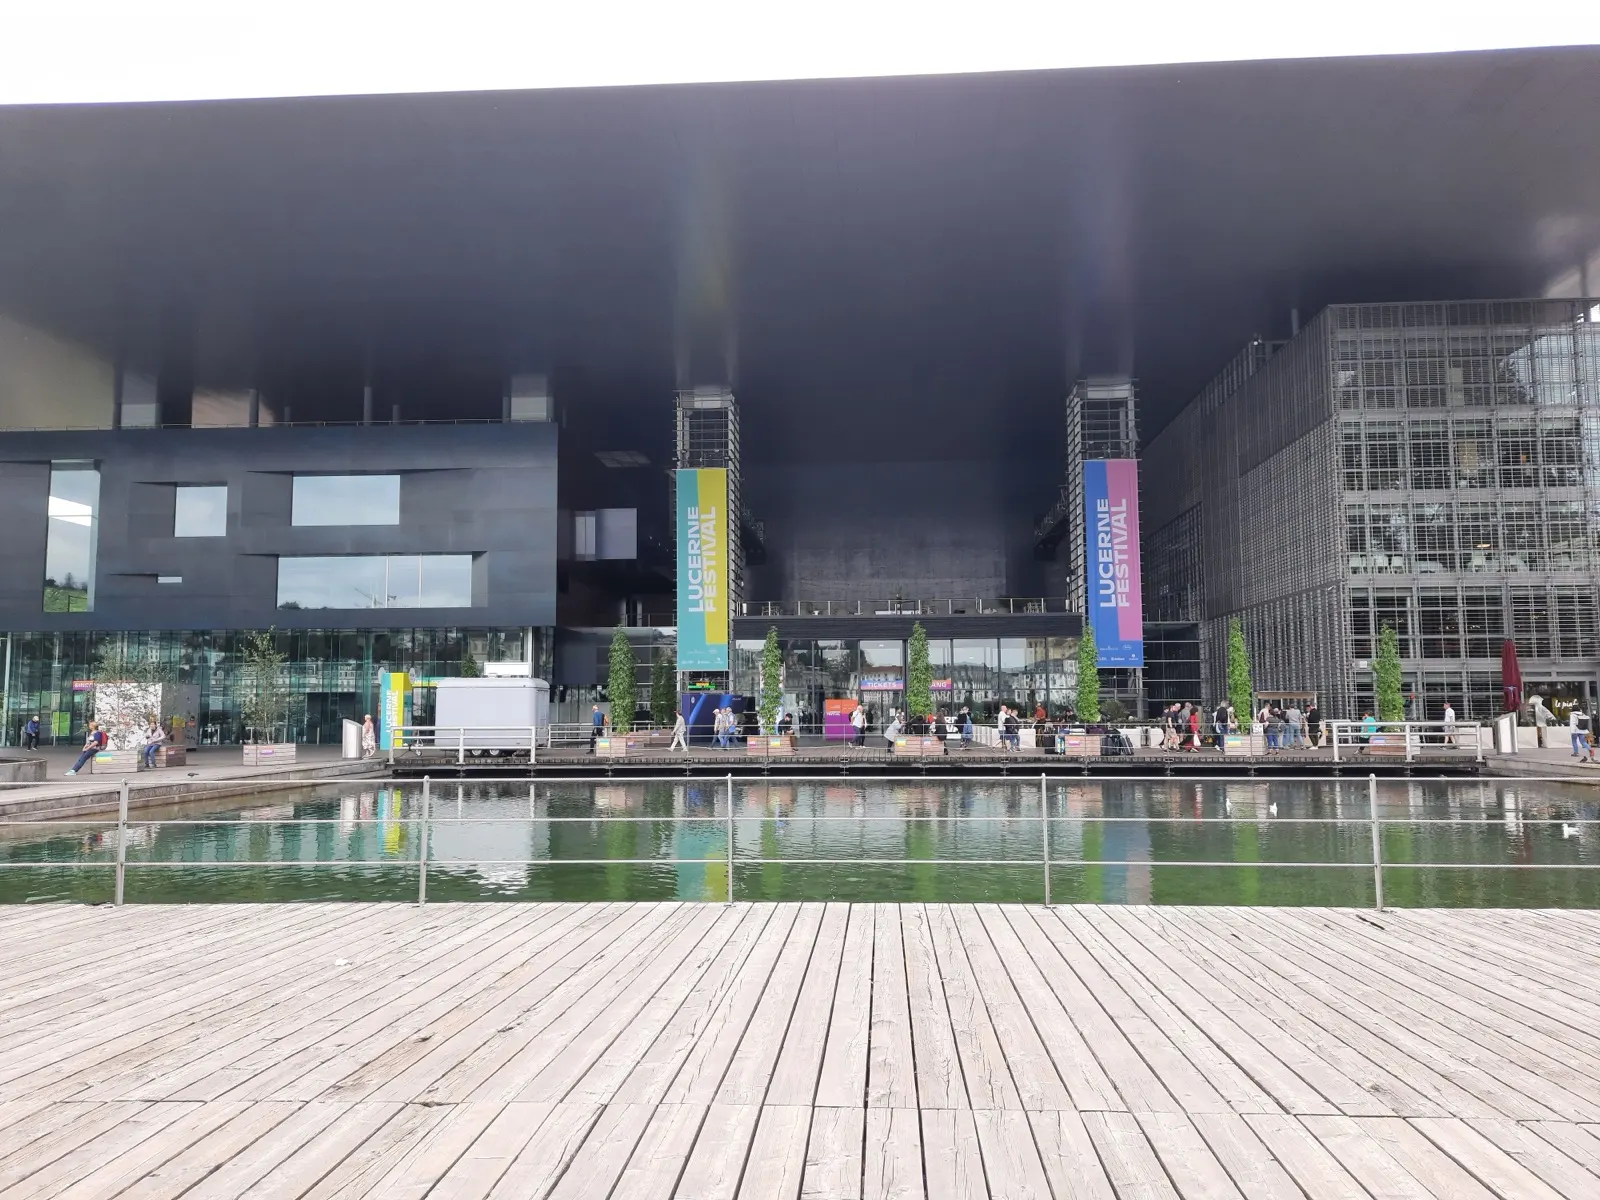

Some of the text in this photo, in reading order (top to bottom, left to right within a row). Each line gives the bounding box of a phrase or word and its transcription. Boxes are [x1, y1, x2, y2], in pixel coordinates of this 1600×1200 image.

[687, 506, 704, 613] LUCERNE
[700, 506, 717, 612] FESTIVAL
[1097, 498, 1117, 608] LUCERNE
[1110, 498, 1130, 607] FESTIVAL
